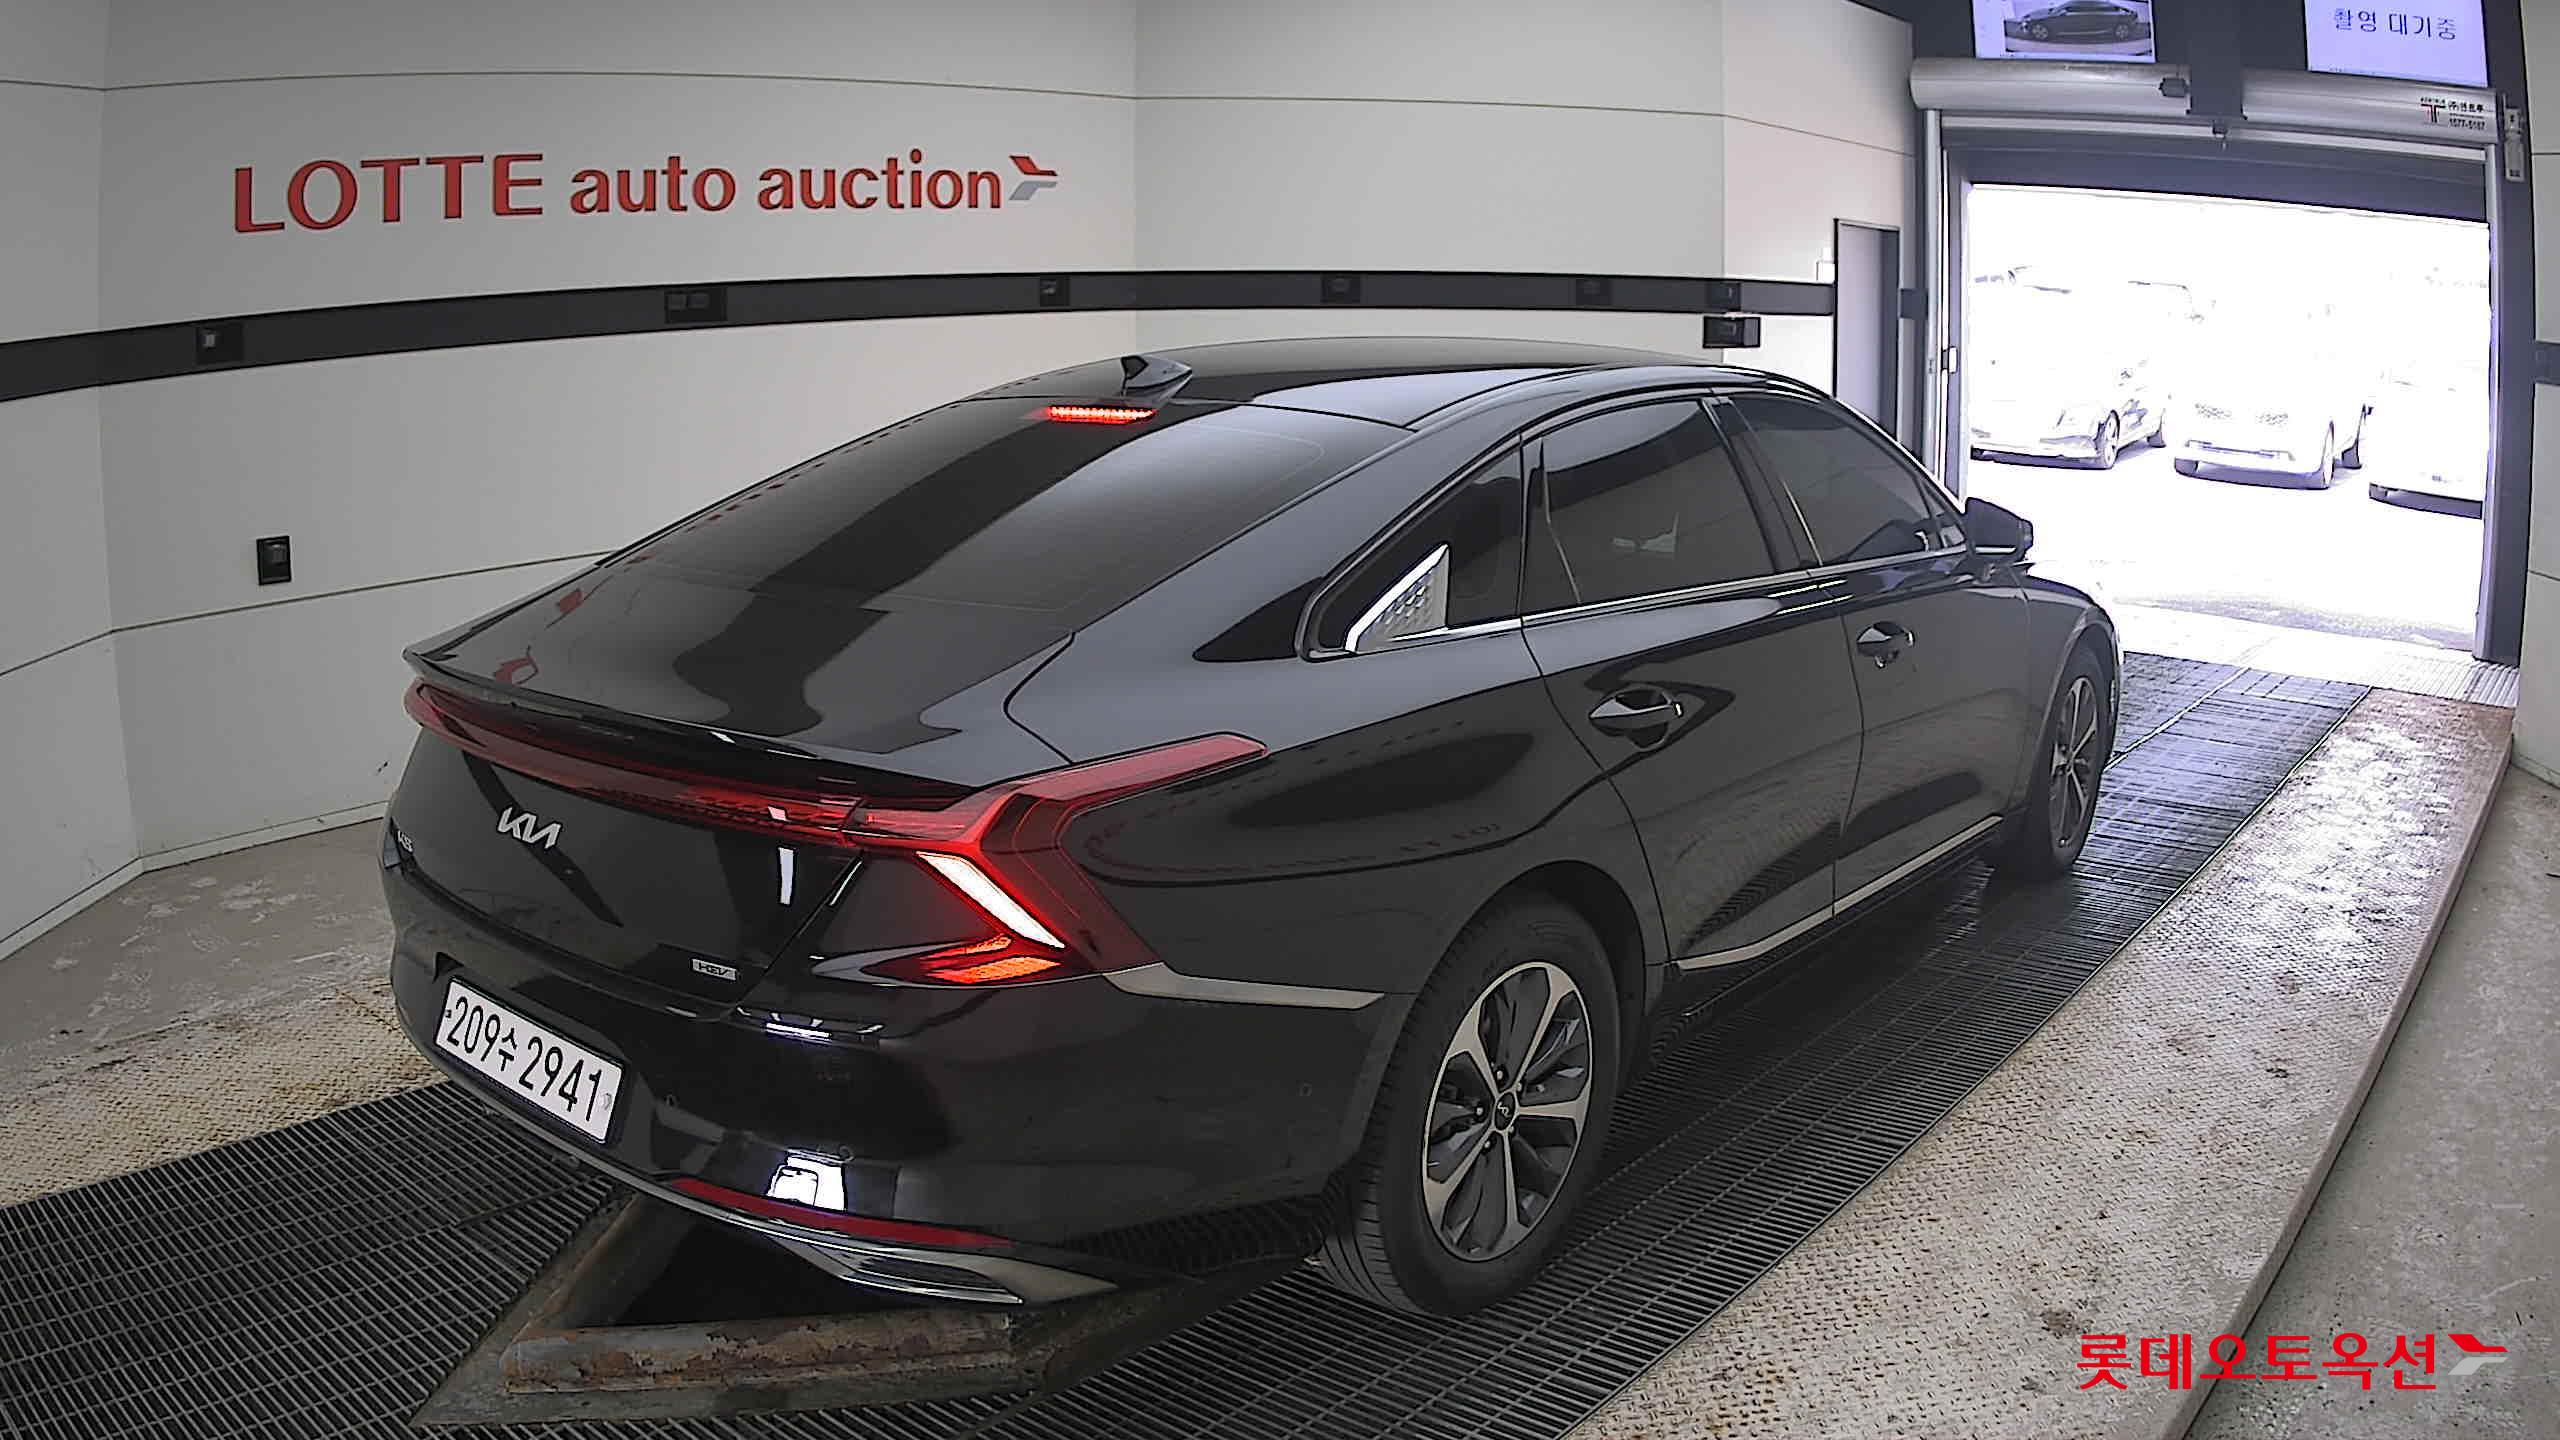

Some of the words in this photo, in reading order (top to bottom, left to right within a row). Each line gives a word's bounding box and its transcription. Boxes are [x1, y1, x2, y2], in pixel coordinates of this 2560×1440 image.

[2388, 13, 2456, 40] 대기중
[234, 153, 543, 233] LOTTE
[569, 155, 736, 214] auto
[758, 148, 1001, 210] auction
[498, 807, 561, 848] KIA
[447, 996, 517, 1071] 209수
[519, 1036, 602, 1121] 2941
